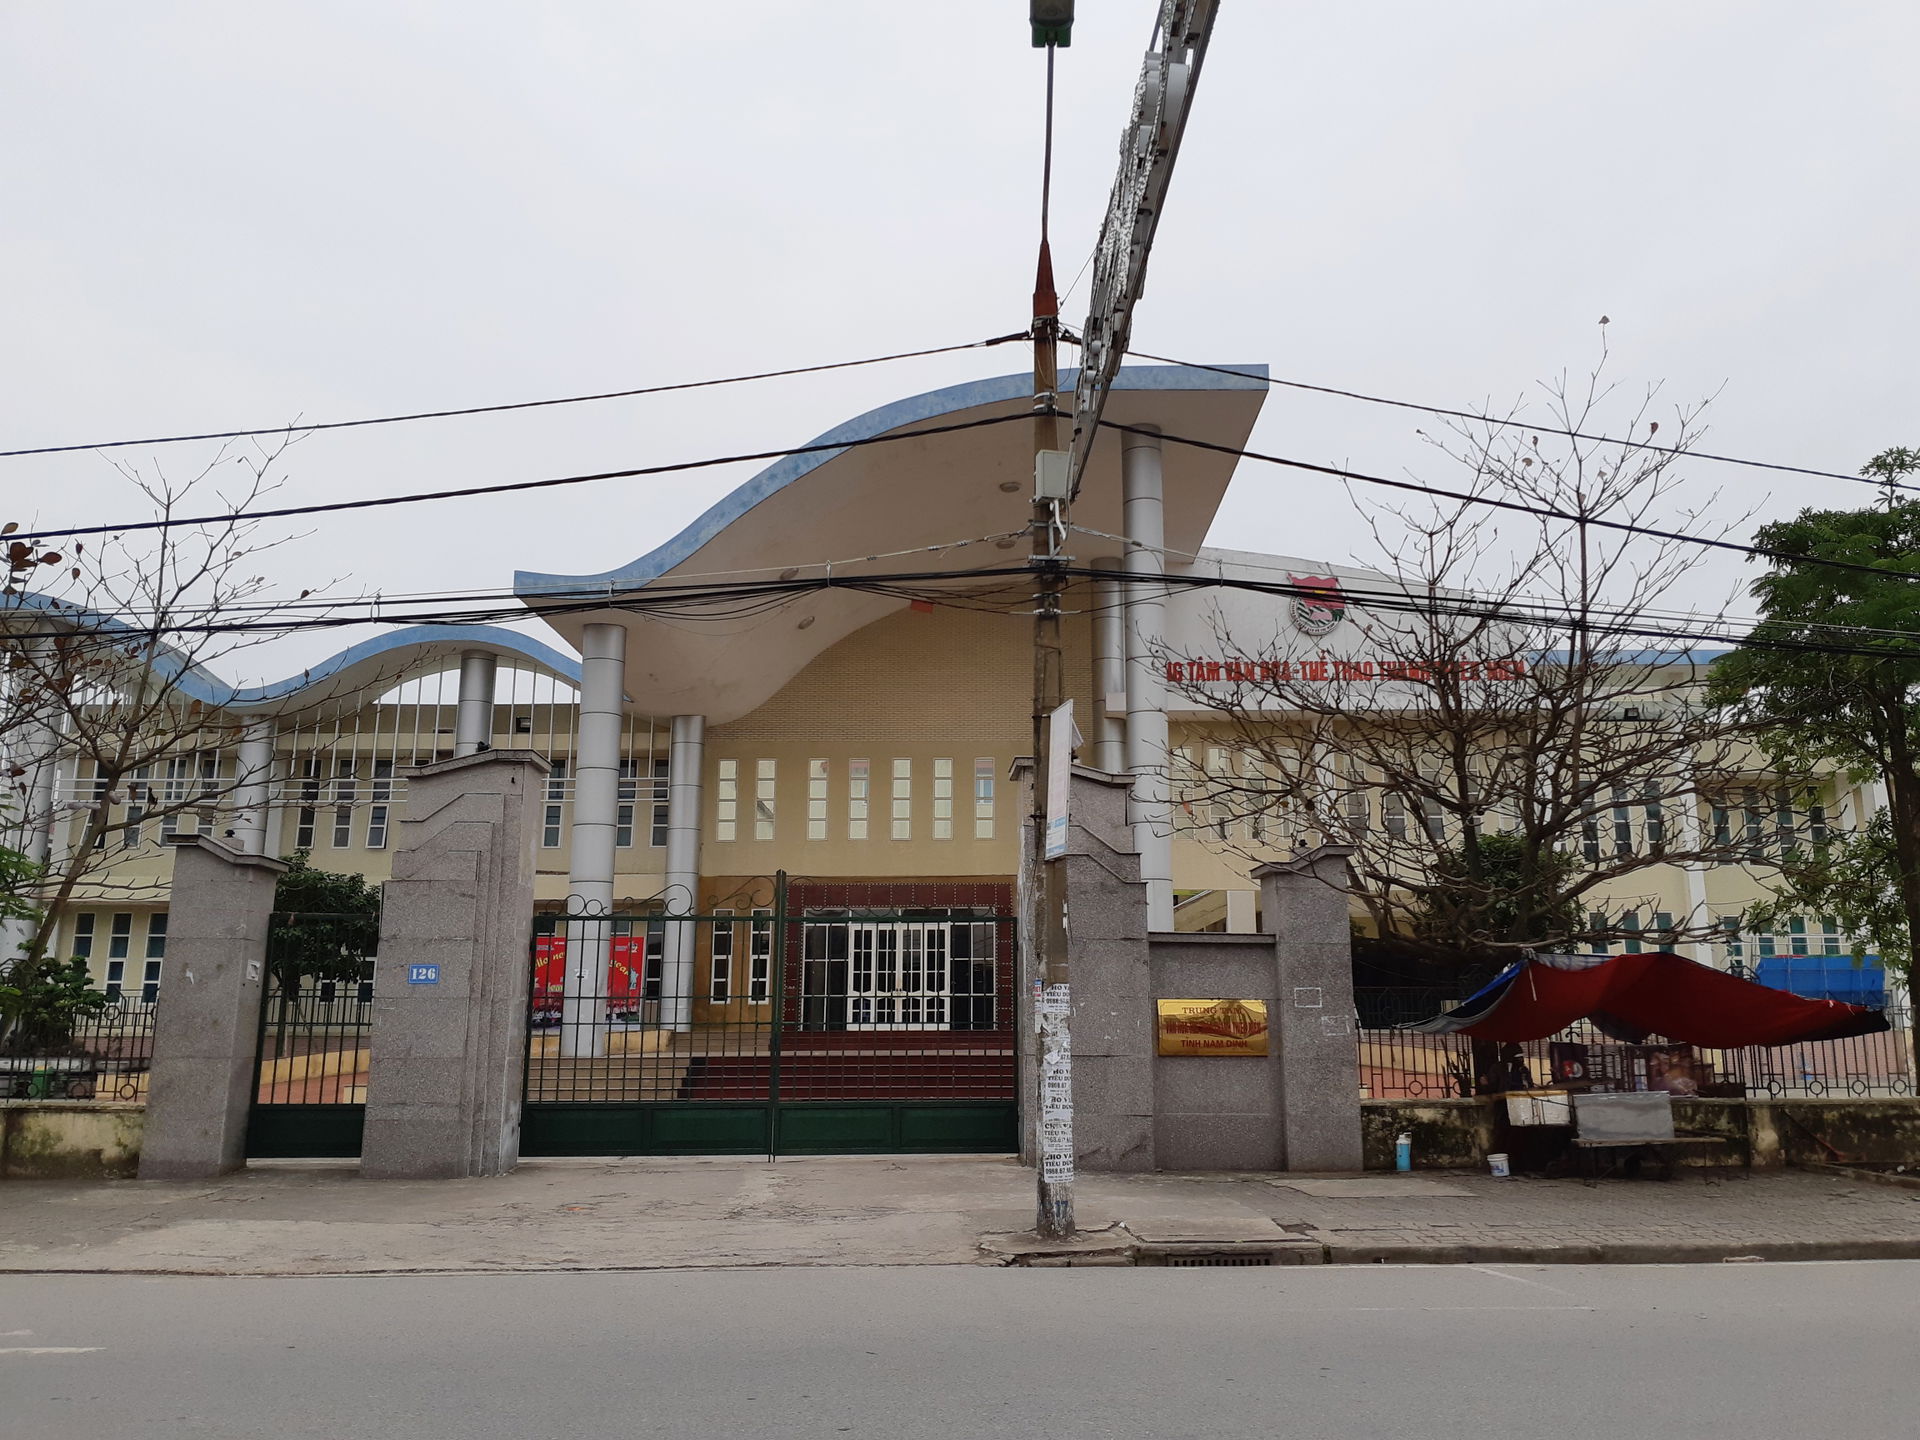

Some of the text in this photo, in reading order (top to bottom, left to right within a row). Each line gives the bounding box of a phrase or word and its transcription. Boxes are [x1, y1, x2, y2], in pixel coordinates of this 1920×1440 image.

[1187, 656, 1220, 682] TÂM
[412, 968, 436, 980] 126
[1181, 1006, 1217, 1014] TRUNG
[1203, 1039, 1224, 1048] NAM
